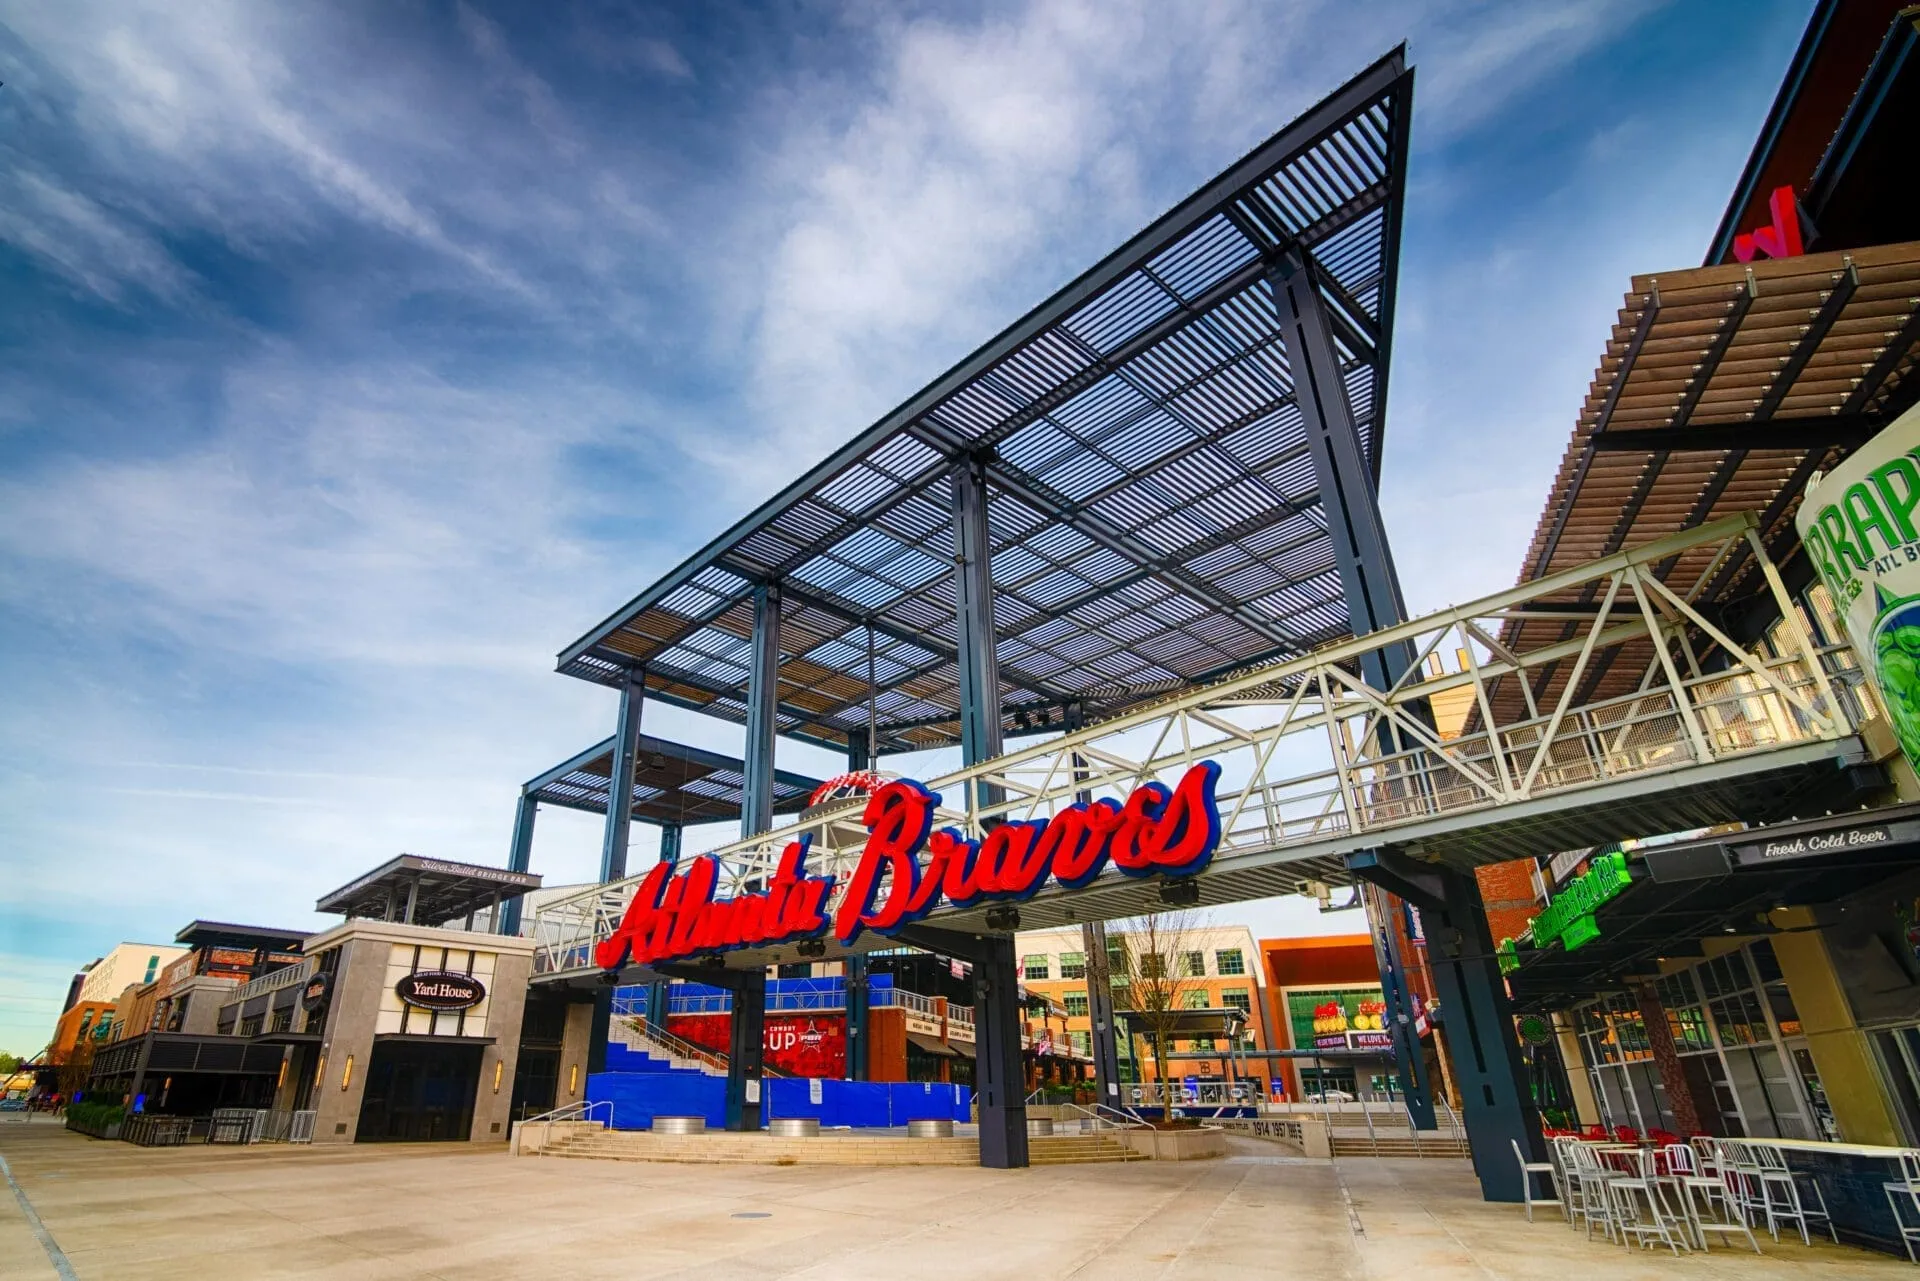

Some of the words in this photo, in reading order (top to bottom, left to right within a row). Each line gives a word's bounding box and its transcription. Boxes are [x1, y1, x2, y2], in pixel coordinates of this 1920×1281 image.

[1874, 553, 1902, 577] ATL
[1765, 839, 1806, 857] Fresh
[1808, 834, 1846, 850] Cold
[1849, 830, 1886, 845] Beer
[421, 859, 448, 872] Silver
[449, 864, 476, 876] Bullet
[477, 871, 508, 881] BRIDGE
[510, 874, 527, 884] BAR
[597, 832, 835, 970] Atlanta
[834, 759, 1222, 946] Braves
[413, 981, 438, 996] Yard
[440, 983, 472, 999] House
[769, 1032, 796, 1051] UP
[1235, 1122, 1249, 1130] TITLES
[1253, 1122, 1270, 1137] 1914
[1272, 1122, 1287, 1137] 1957
